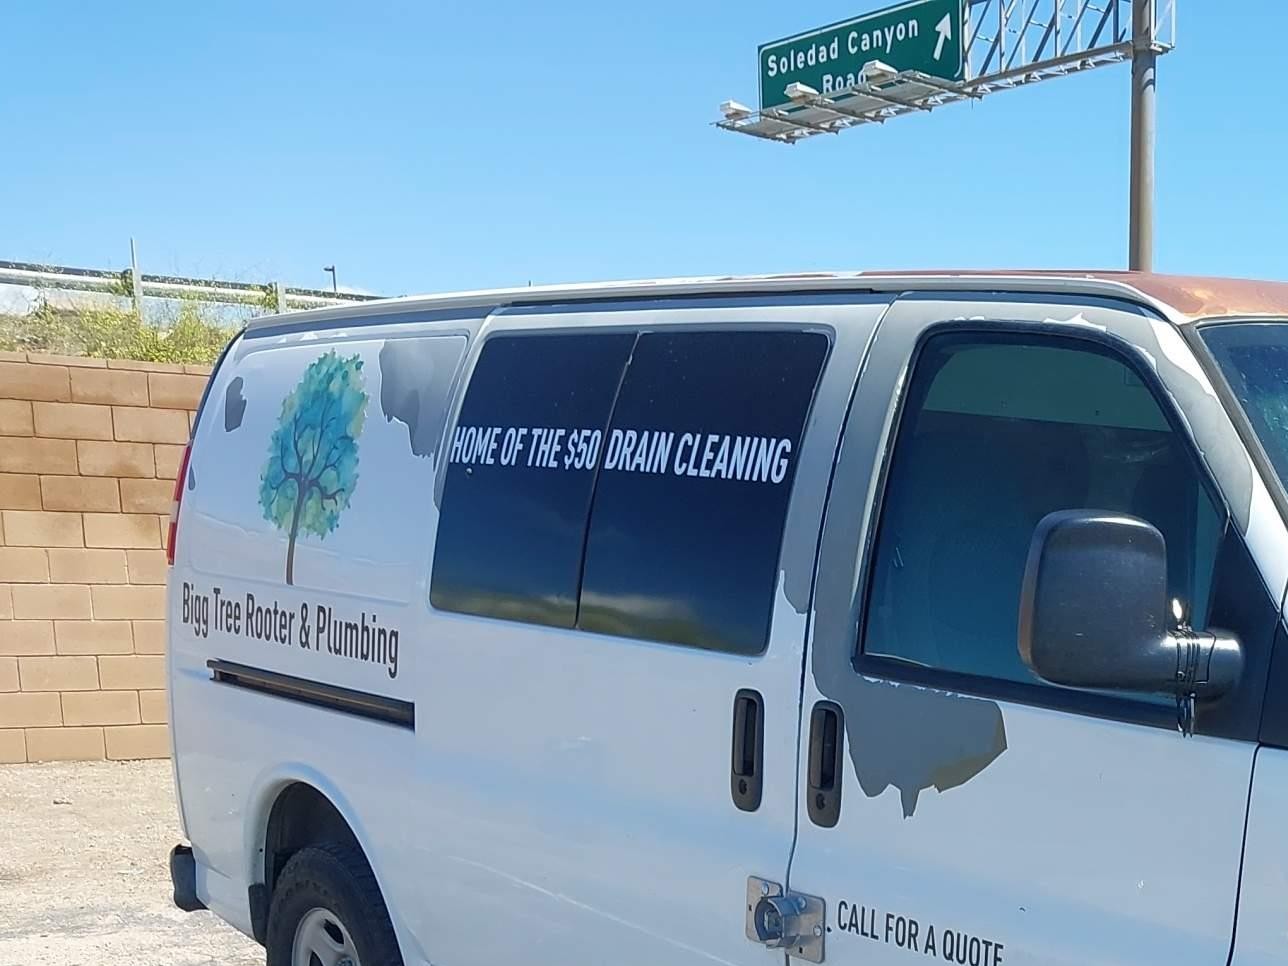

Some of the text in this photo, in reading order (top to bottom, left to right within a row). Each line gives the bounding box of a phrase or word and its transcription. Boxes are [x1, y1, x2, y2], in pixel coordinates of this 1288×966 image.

[767, 19, 919, 77] Soledad Canyon
[449, 426, 792, 484] HOME OF THE $50 DRAIN CLEANING
[182, 582, 399, 680] Bigg Tree Rooter & Plumbing
[837, 900, 880, 941] CALL
[885, 912, 919, 952] FOR
[924, 925, 937, 957] A
